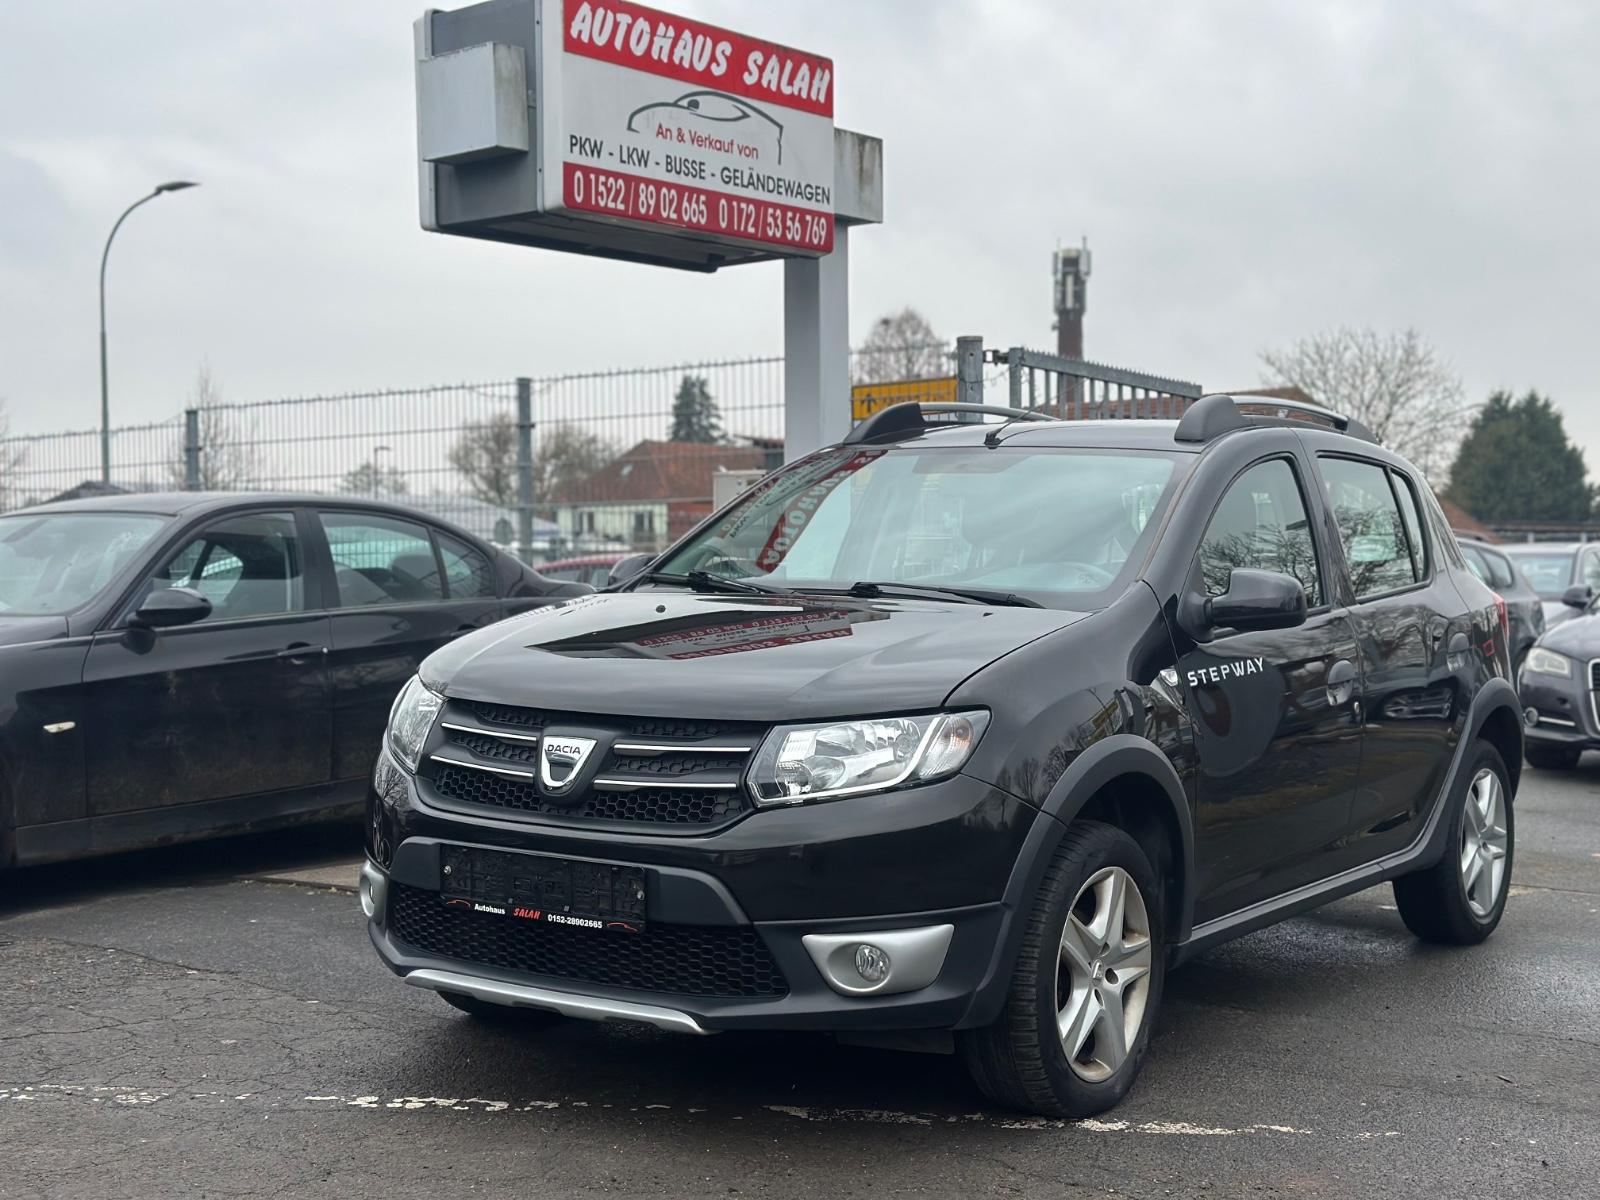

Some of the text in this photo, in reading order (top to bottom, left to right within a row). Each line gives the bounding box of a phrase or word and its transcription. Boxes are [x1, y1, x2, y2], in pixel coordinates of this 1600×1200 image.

[570, 1, 830, 103] AUTOHAUS SALAH
[656, 122, 759, 159] An & Verkauf von
[569, 134, 603, 159] PKW
[619, 144, 650, 168] LKW
[665, 154, 706, 180] BUSSE
[720, 166, 831, 205] GELÄNDEWAGEN
[573, 170, 584, 203] 0
[589, 173, 625, 210] 1522
[638, 183, 656, 215] 89
[660, 187, 678, 219] 02
[681, 191, 707, 224] 665
[718, 198, 728, 229] 0
[732, 201, 756, 234] 172
[766, 207, 782, 239] 53
[785, 211, 801, 241] 56
[804, 214, 828, 245] 769
[1187, 657, 1265, 687] STEPWAY
[547, 744, 581, 754] DACIA
[474, 903, 506, 915] Autohaus
[513, 907, 541, 920] SALAH
